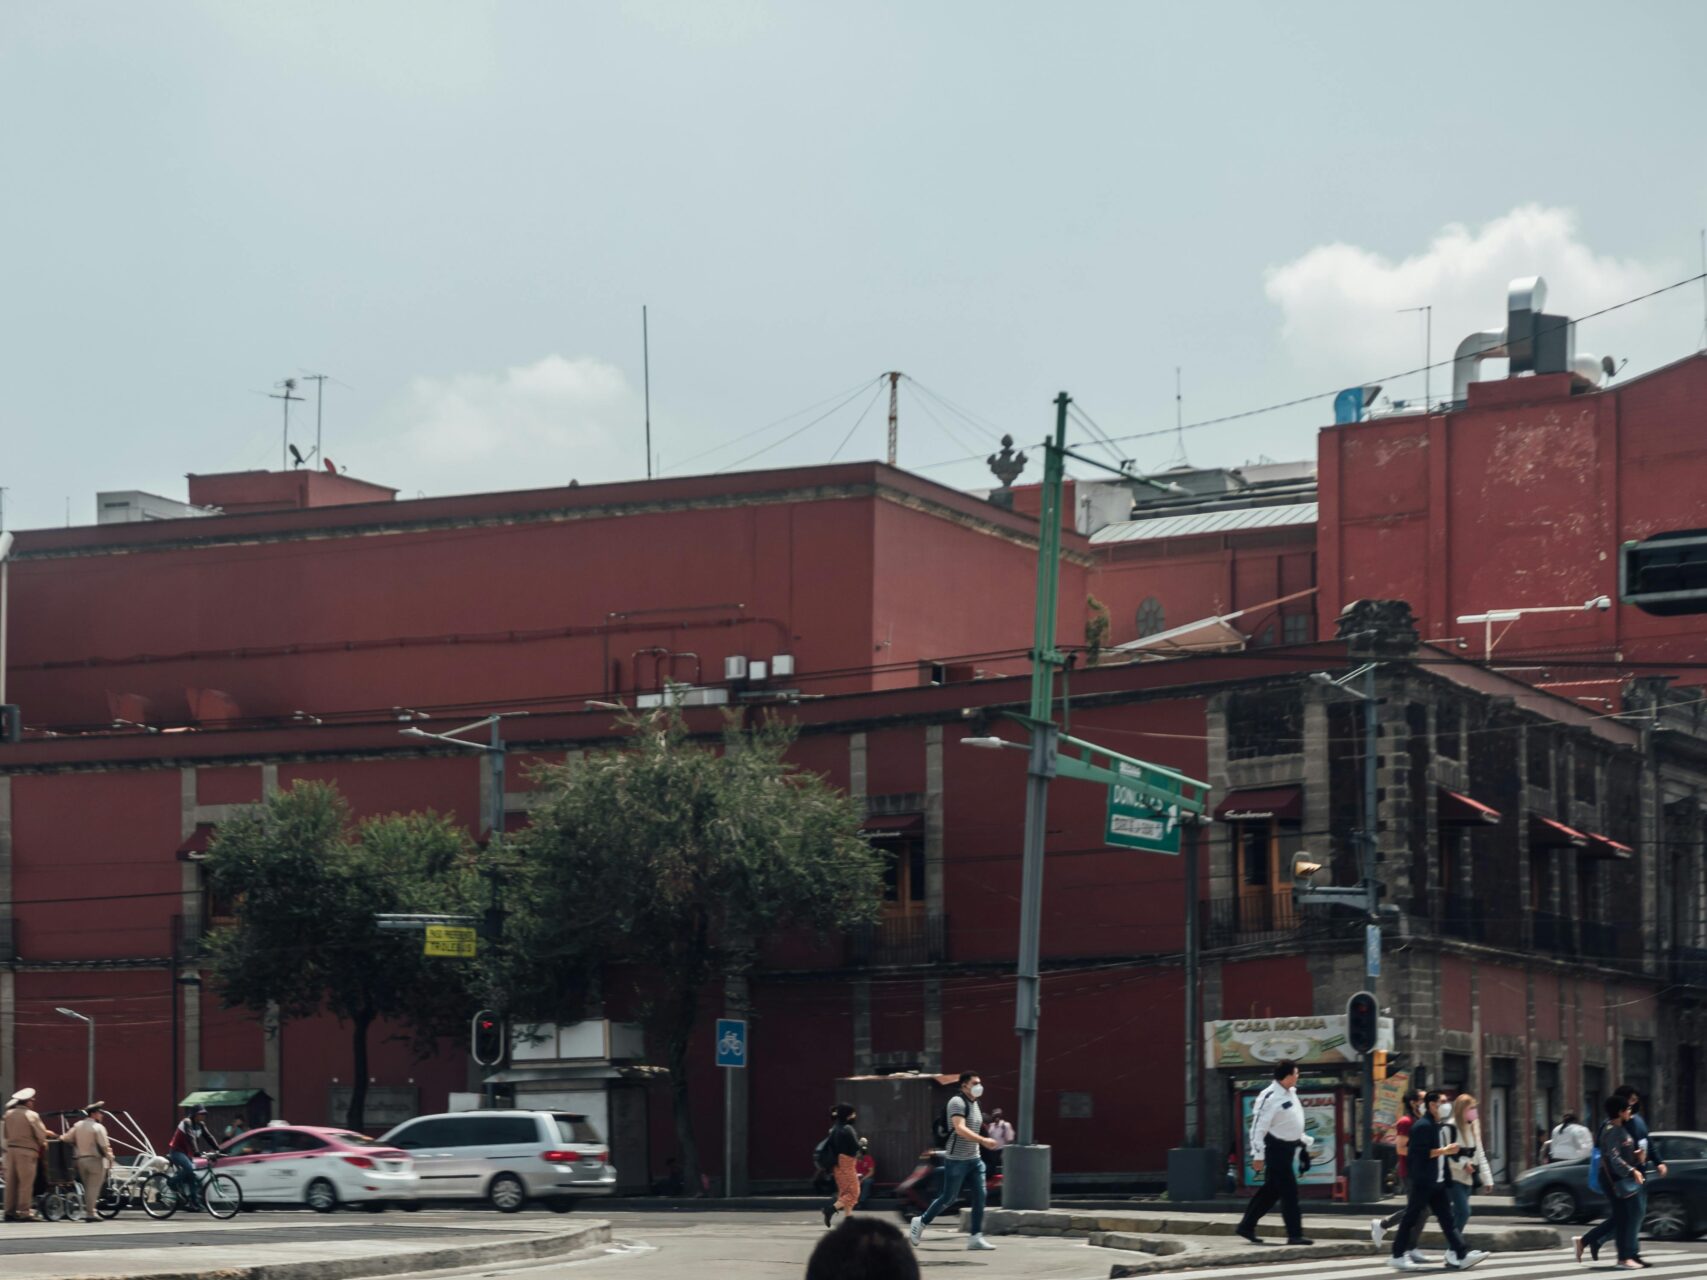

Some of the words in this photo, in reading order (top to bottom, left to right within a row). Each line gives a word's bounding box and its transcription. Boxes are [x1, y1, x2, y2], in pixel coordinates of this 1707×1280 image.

[1234, 1021, 1271, 1033] CASA
[1274, 1018, 1328, 1031] MOLINA
[1302, 1096, 1335, 1108] OLINA
